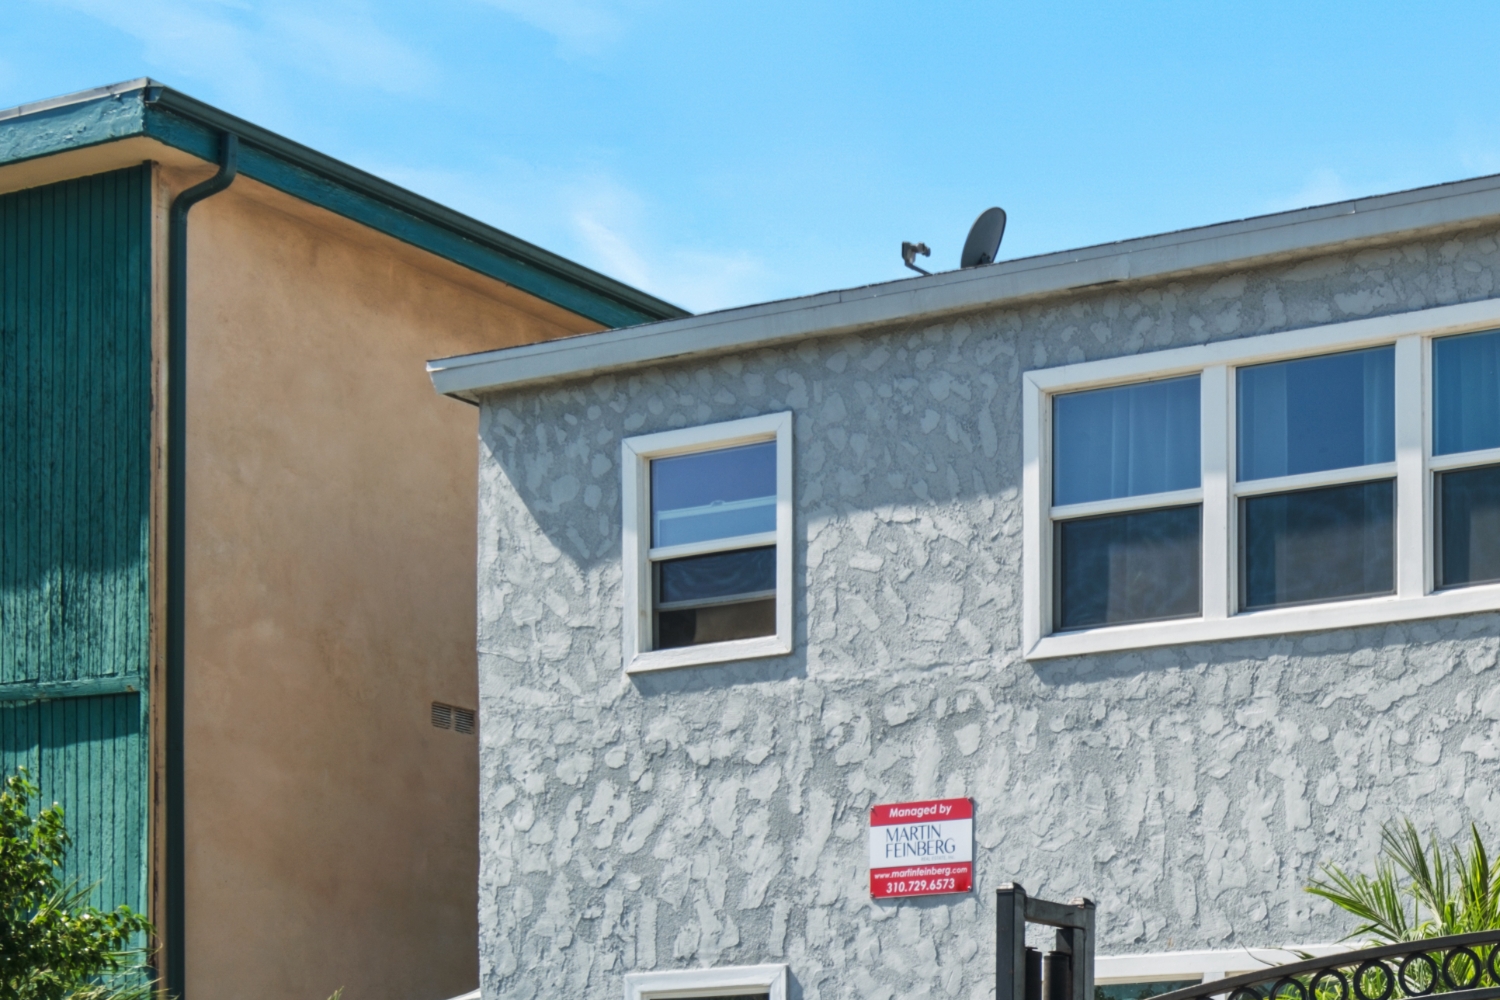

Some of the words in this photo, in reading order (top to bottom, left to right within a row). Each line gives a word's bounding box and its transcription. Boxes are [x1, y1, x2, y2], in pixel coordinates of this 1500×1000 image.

[889, 806, 937, 818] Managed
[939, 804, 952, 815] by
[885, 823, 942, 843] MARTIN
[885, 837, 956, 858] FEINBERG
[874, 866, 968, 880] www.martinfeinberg.com
[886, 878, 955, 894] 310.729.6573
